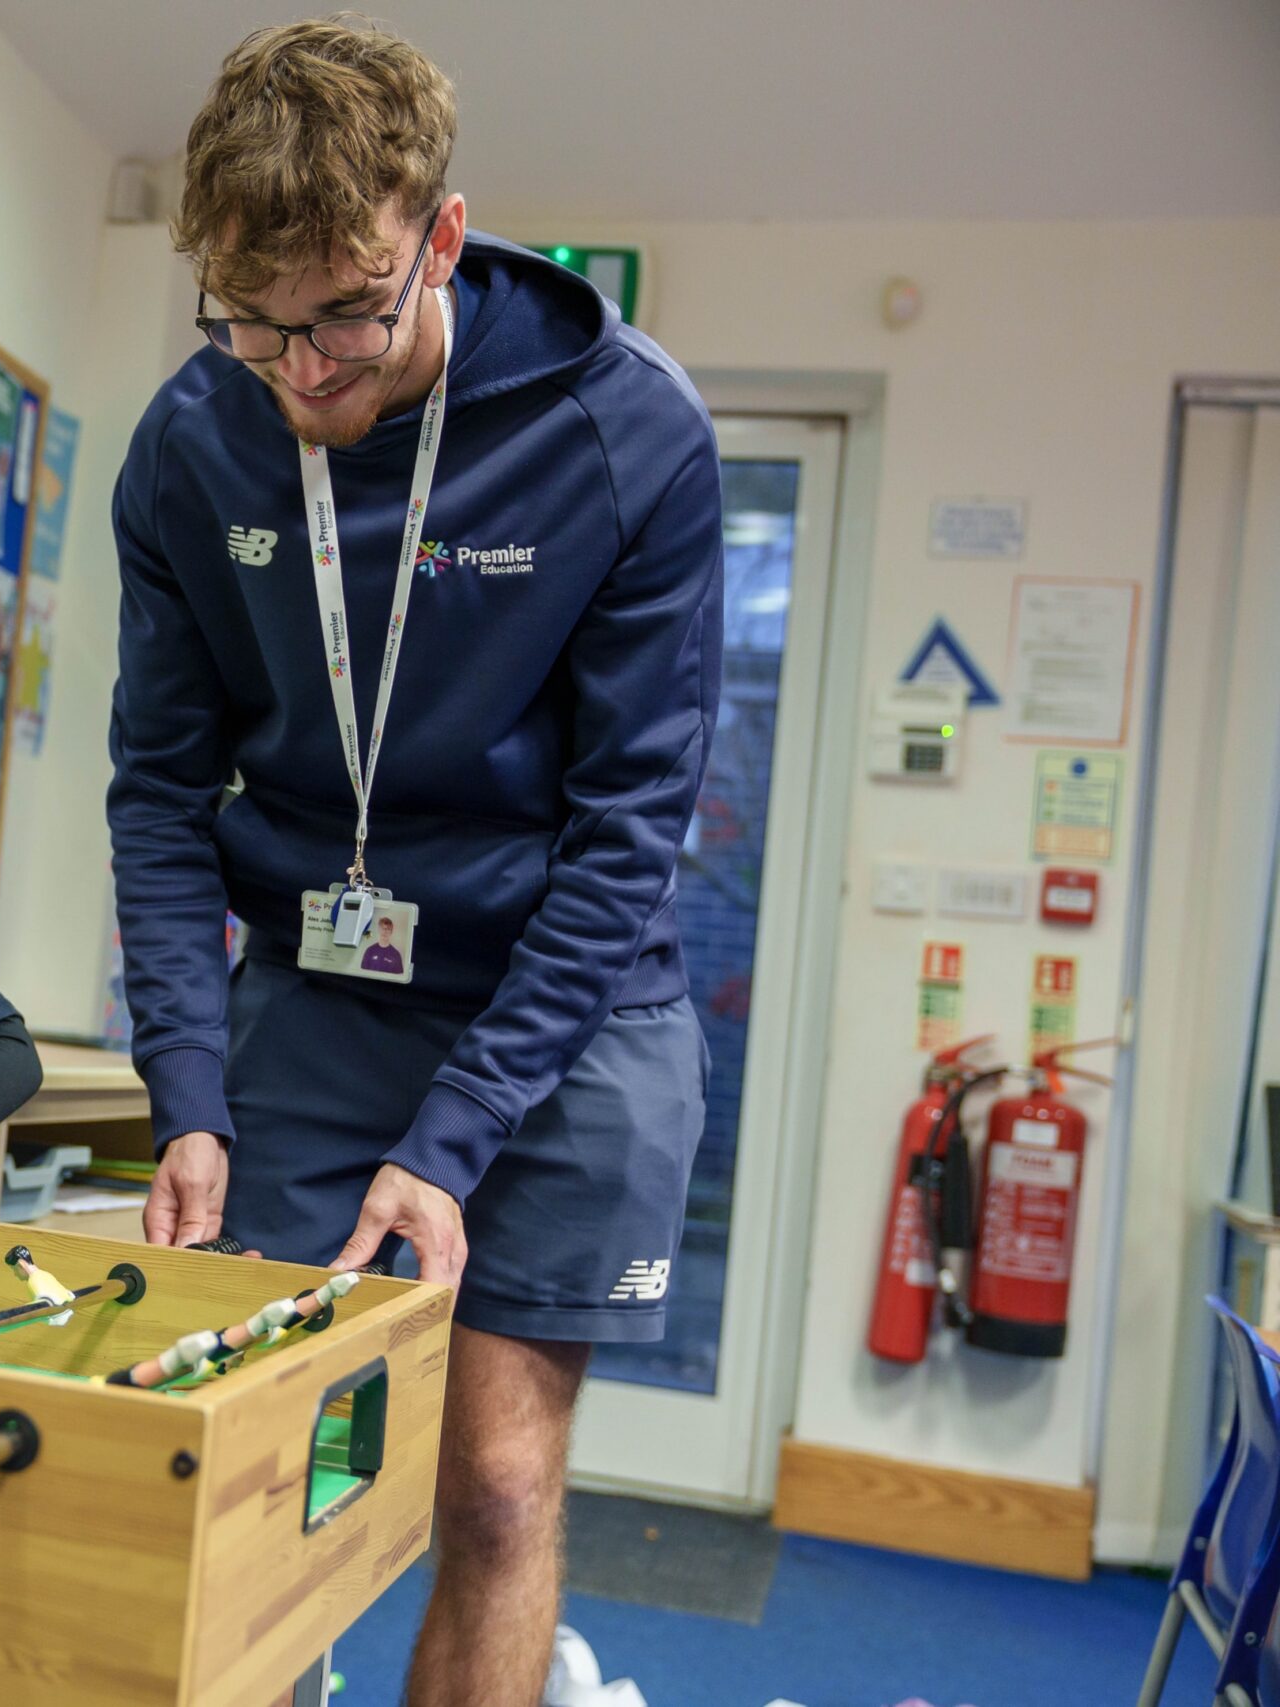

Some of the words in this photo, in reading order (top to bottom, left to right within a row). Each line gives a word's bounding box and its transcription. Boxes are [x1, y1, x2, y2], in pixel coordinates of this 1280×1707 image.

[424, 408, 437, 452] Premier
[316, 500, 329, 543] Premier
[404, 523, 417, 567] Premier
[457, 543, 536, 566] Premier
[480, 563, 534, 575] Education
[330, 611, 341, 654] Premier
[384, 639, 396, 681] Premier
[346, 723, 355, 767] Premier
